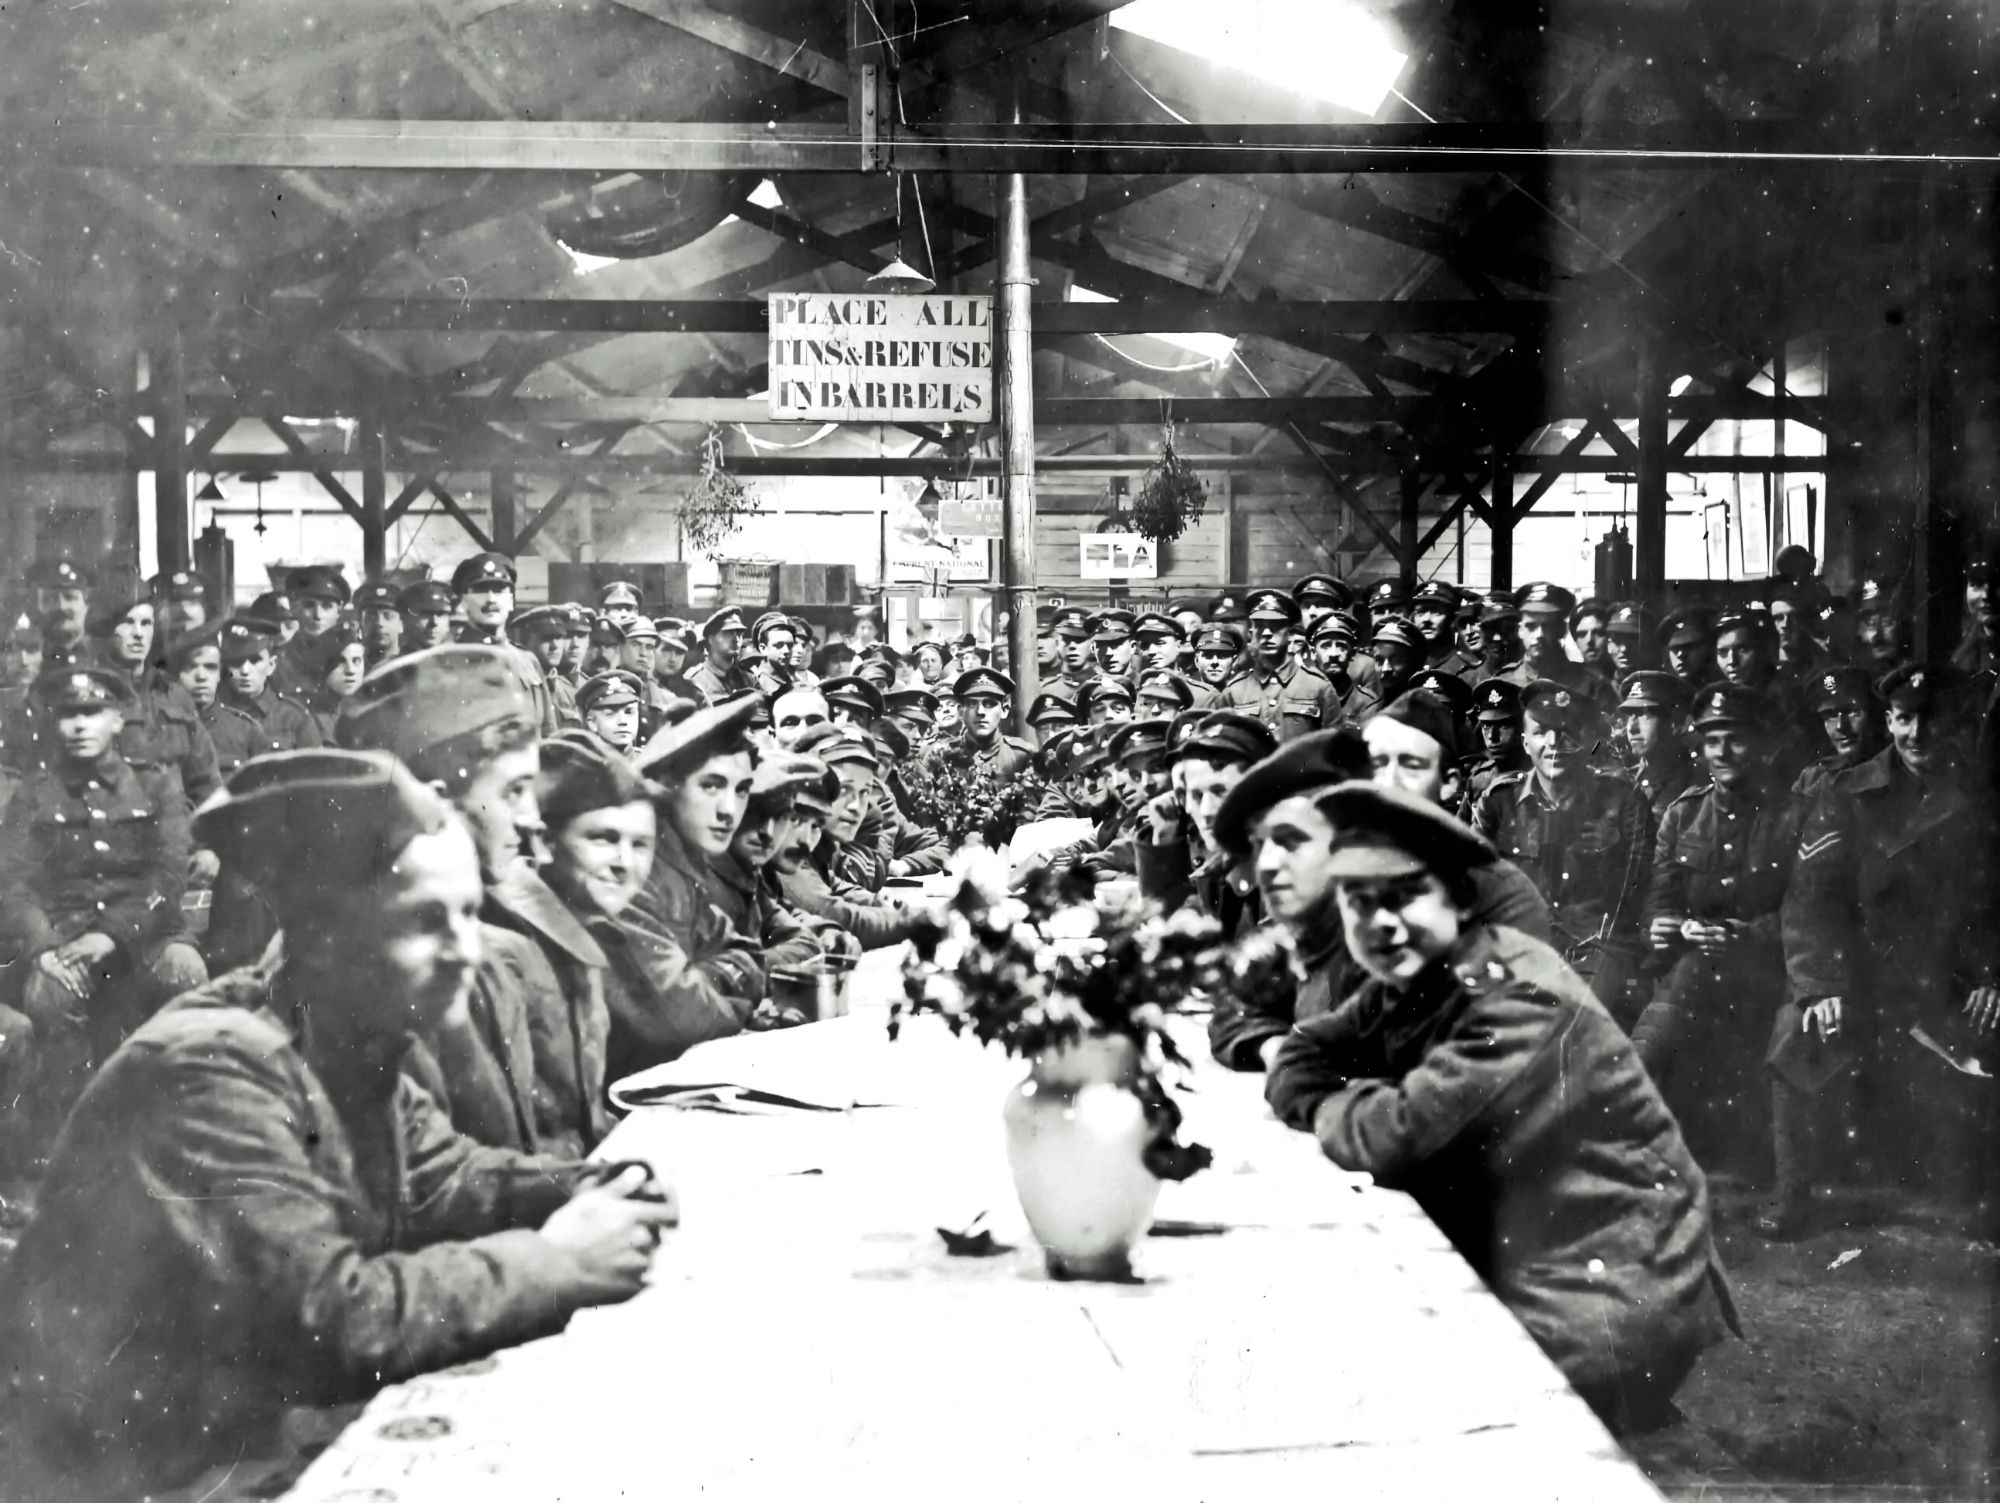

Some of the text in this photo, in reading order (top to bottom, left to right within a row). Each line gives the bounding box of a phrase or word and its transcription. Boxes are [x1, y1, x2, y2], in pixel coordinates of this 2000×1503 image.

[776, 298, 988, 326] PLACE ALL
[780, 381, 982, 409] IN BARRELS
[939, 560, 984, 568] NATIONAL
